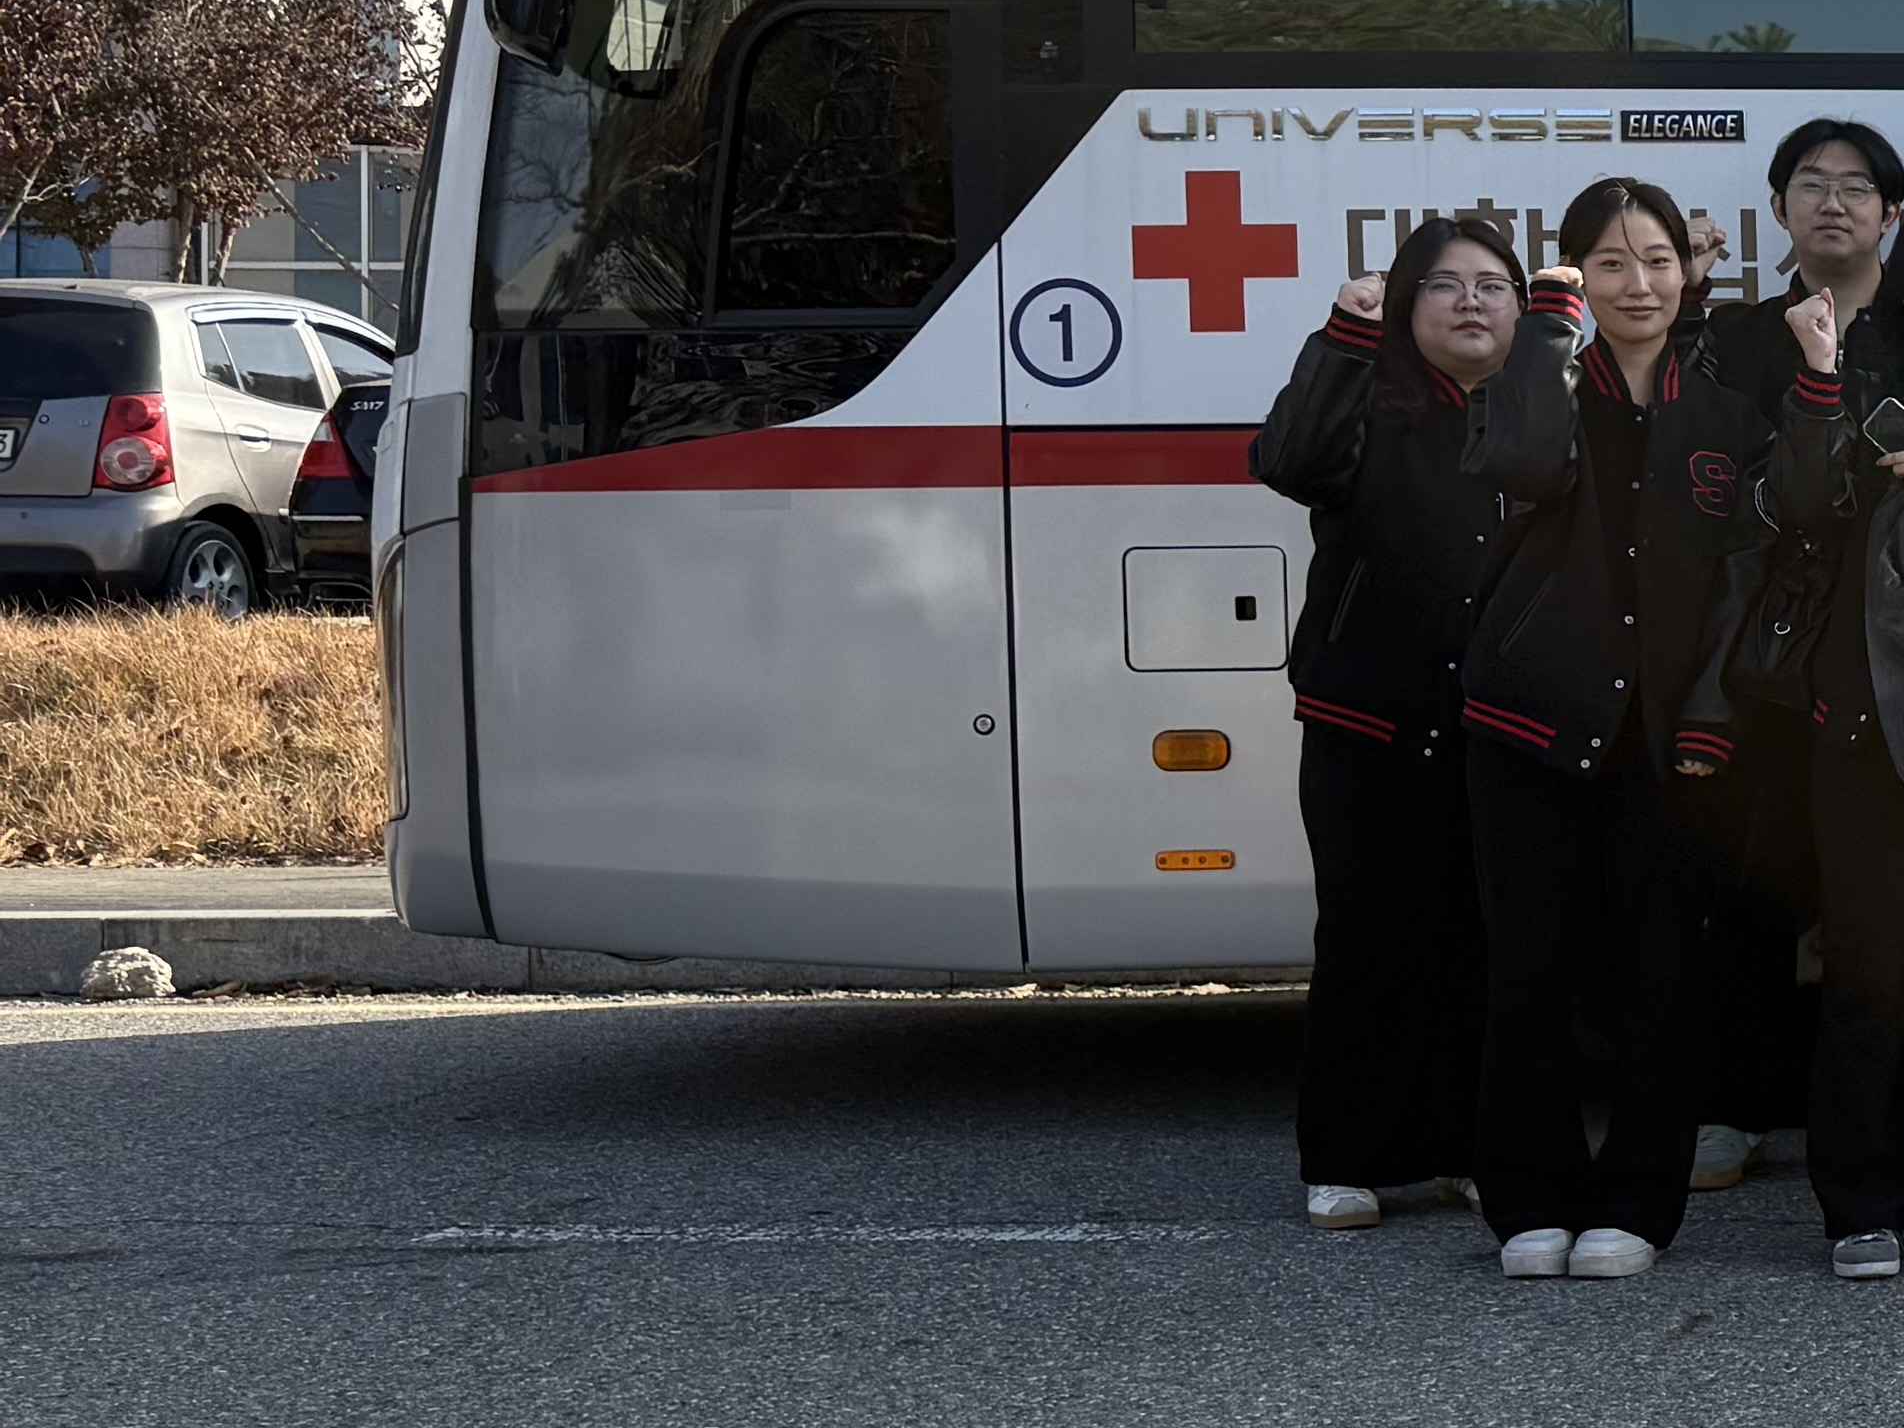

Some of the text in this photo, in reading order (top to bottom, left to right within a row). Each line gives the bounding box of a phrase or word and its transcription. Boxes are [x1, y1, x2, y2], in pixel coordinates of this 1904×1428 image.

[1137, 106, 1739, 143] UNIVERSE ELEGANCE
[1689, 450, 1738, 517] S
